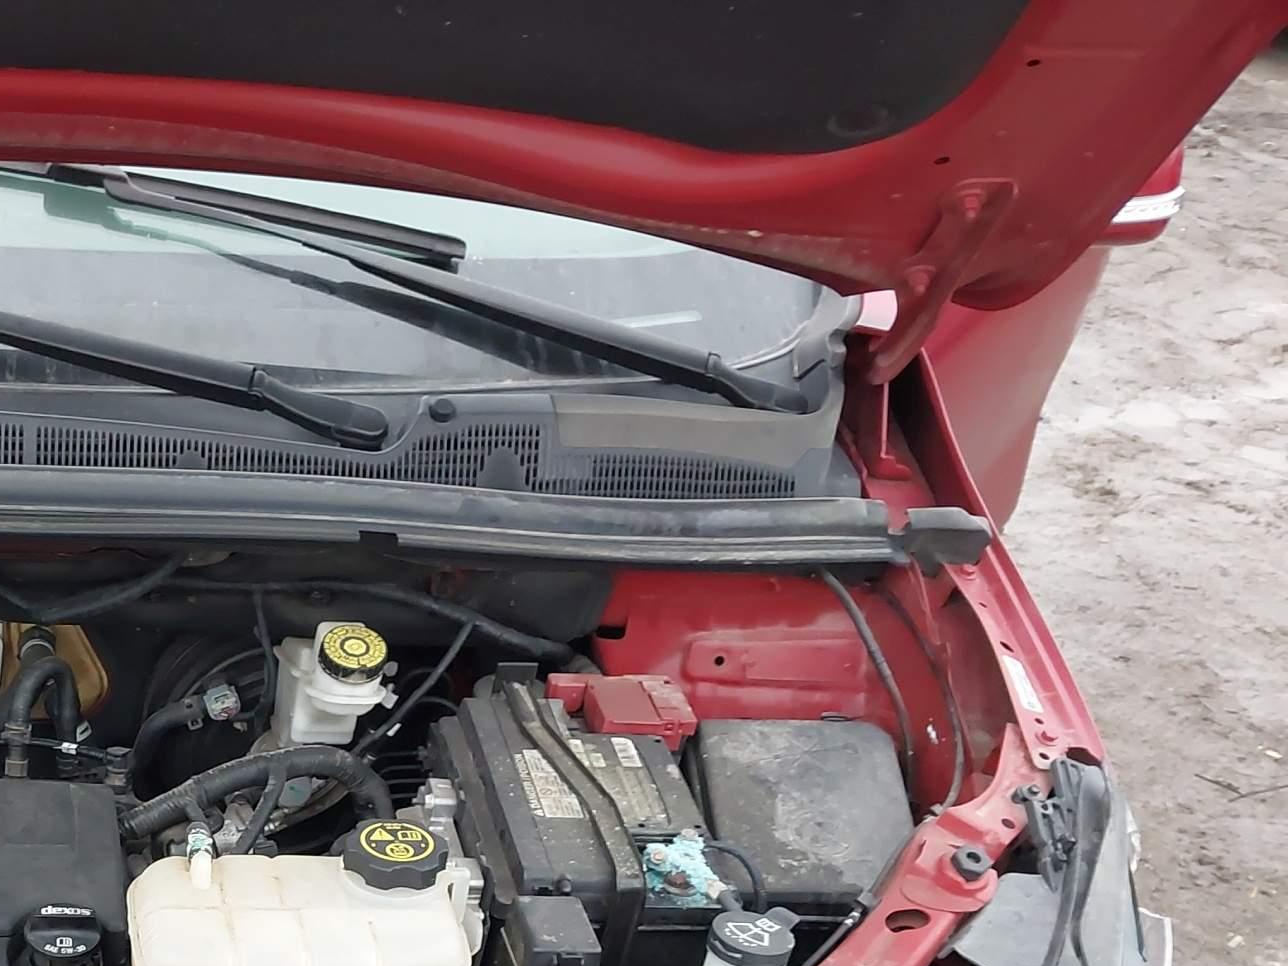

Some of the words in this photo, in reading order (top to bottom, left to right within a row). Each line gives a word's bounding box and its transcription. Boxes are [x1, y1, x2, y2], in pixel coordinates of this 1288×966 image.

[40, 905, 93, 916] dexos
[43, 944, 59, 954] SAE
[60, 944, 87, 954] 5W-30
